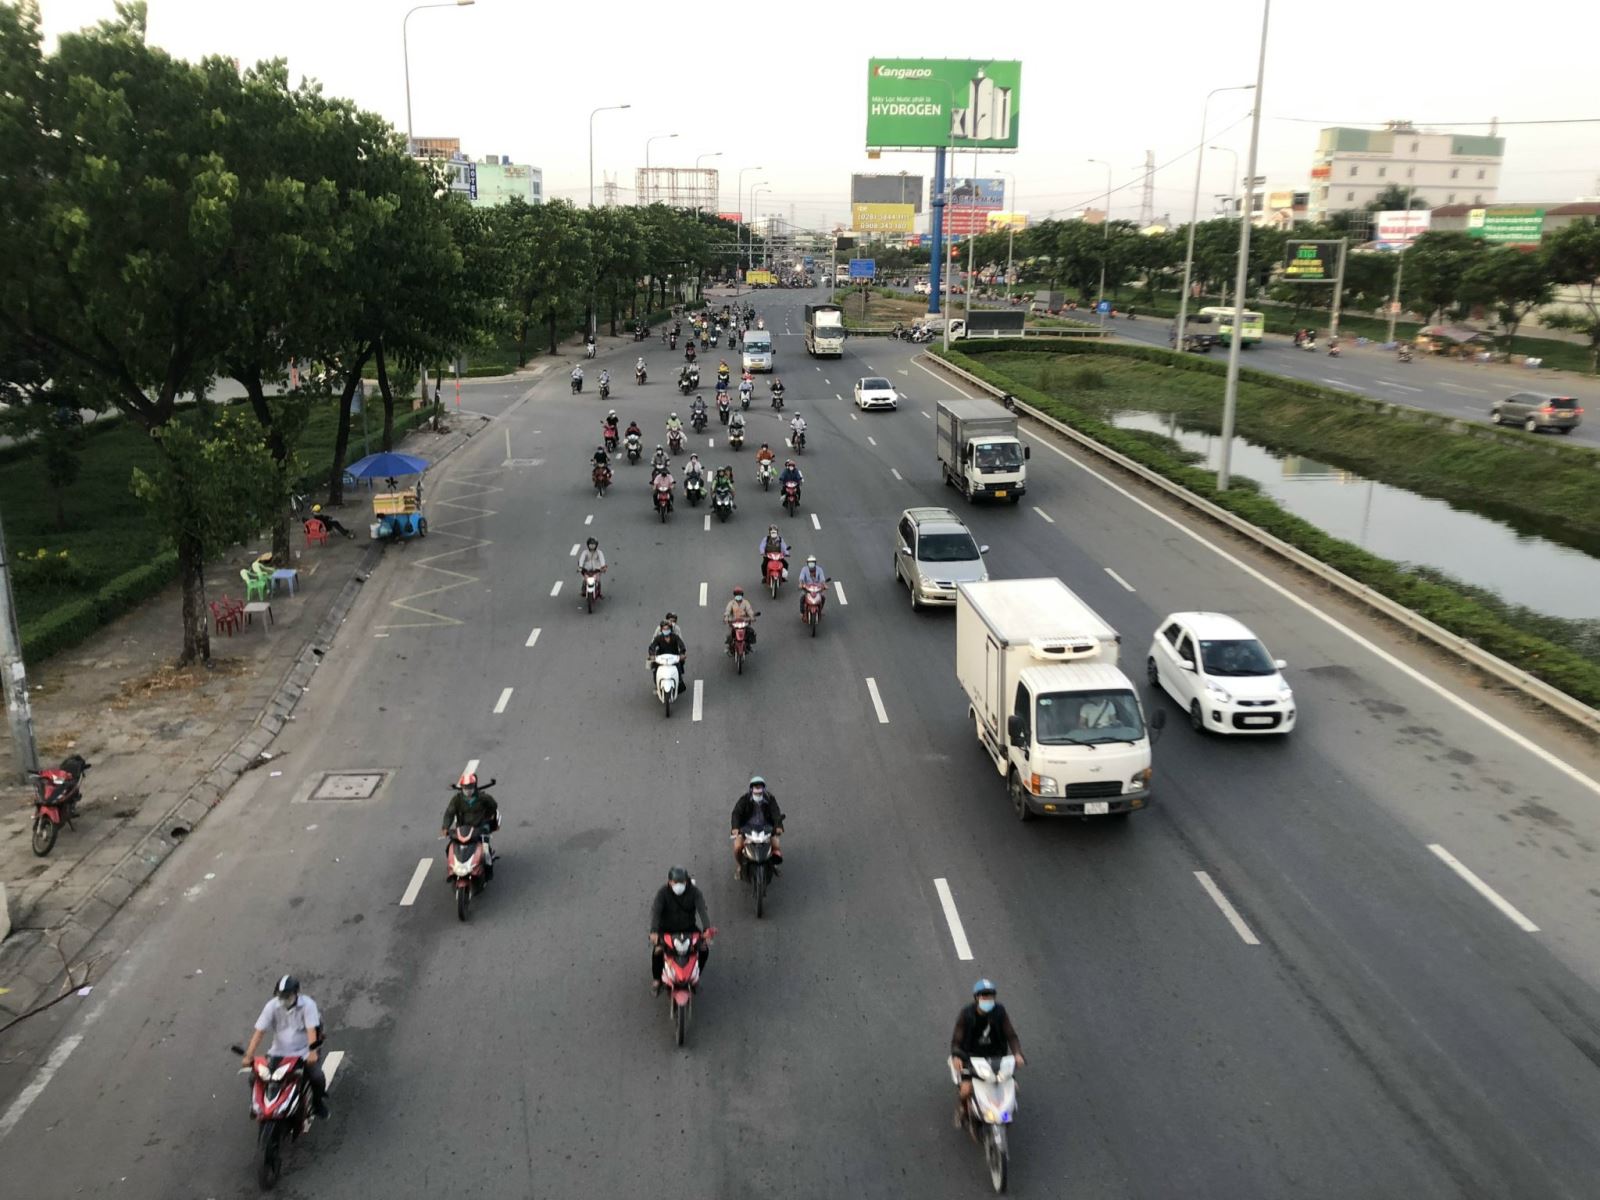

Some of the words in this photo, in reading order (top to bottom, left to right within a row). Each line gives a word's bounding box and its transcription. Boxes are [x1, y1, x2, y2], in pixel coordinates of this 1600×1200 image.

[873, 65, 932, 79] Kangaroo
[872, 104, 941, 115] HYDROGEN
[469, 163, 477, 199] HOTEL
